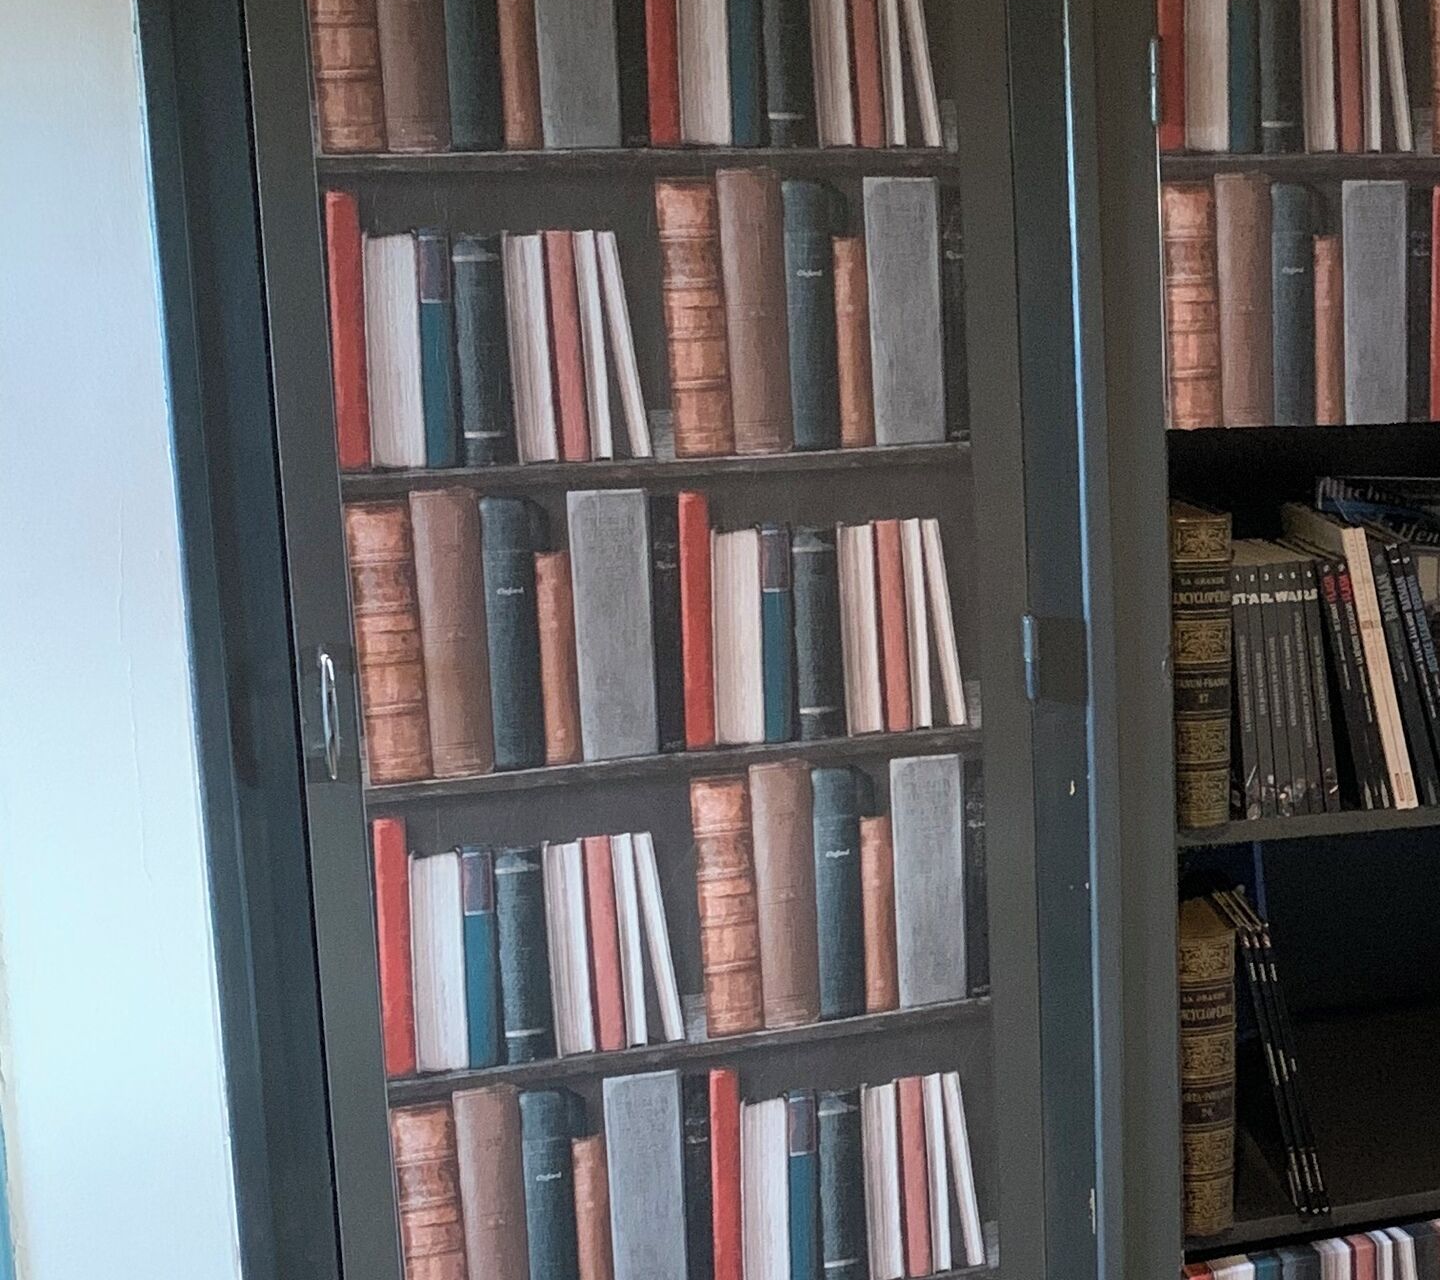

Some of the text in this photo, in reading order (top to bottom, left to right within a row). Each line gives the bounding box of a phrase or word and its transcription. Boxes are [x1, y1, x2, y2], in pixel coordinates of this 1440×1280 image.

[496, 586, 525, 596] Oxford
[1232, 588, 1318, 605] STAR WARS
[1323, 574, 1337, 604] FLASH
[1338, 574, 1353, 604] FLASH
[1376, 573, 1399, 621] BATMAN
[1395, 577, 1413, 611] BATMAN
[825, 848, 850, 858] Oxford
[535, 1171, 562, 1182] Oxford
